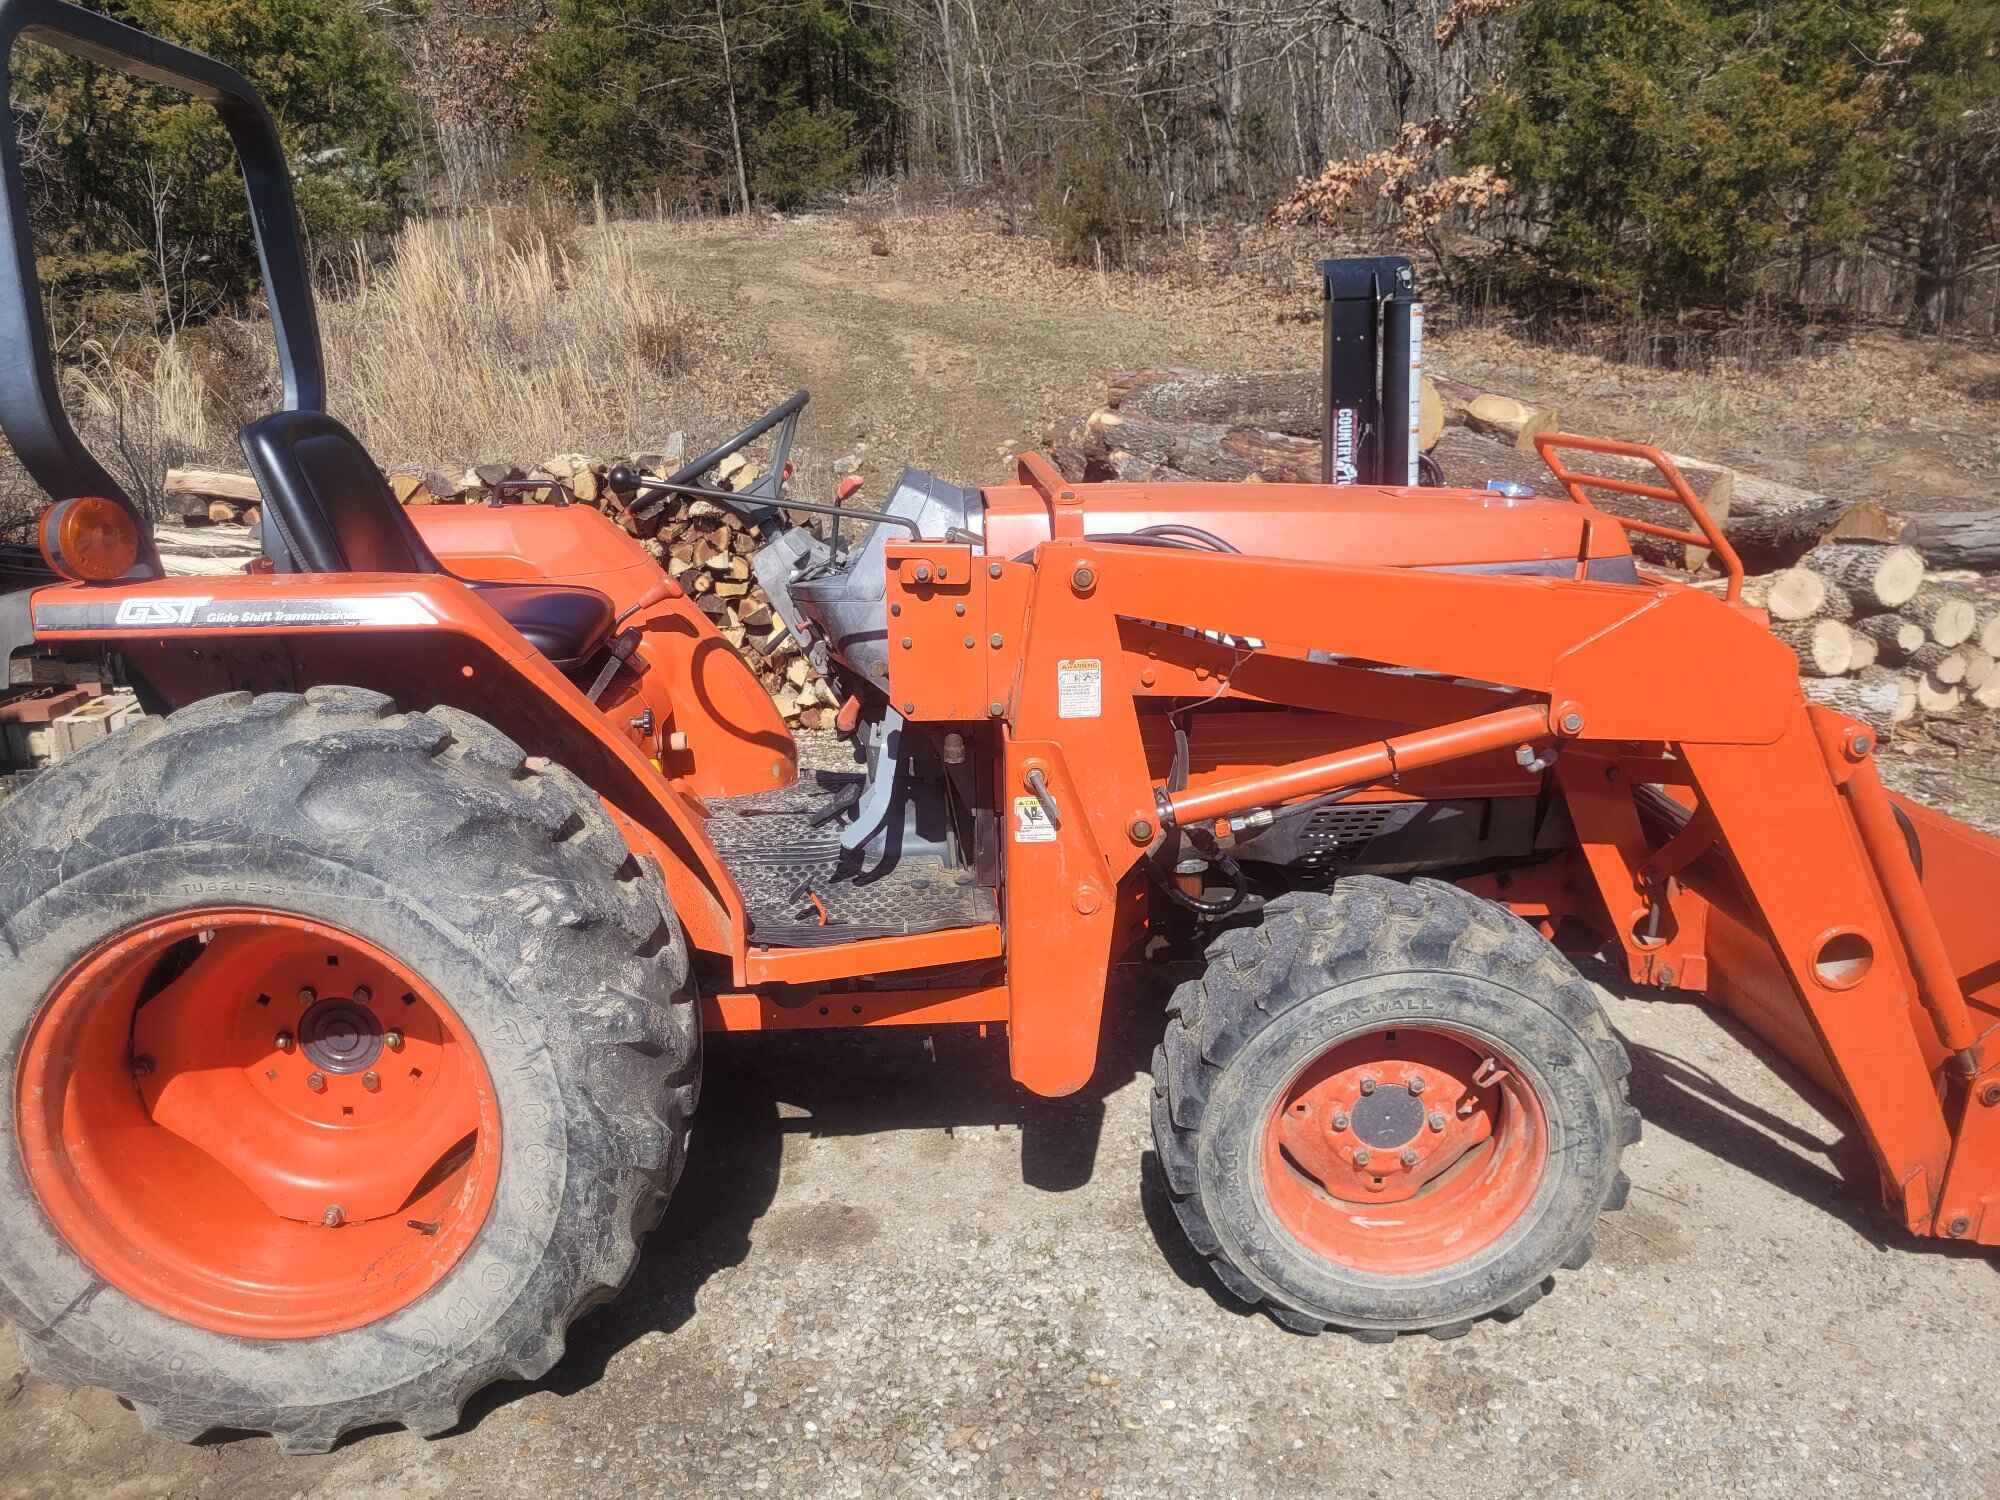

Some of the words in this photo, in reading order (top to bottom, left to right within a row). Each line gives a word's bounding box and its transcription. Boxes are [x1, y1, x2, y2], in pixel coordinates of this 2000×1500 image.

[1336, 408, 1353, 464] COUNTRY
[115, 597, 213, 624] GST
[206, 612, 240, 623] Glide
[242, 611, 272, 623] Shift
[181, 881, 287, 897] TUBELESS
